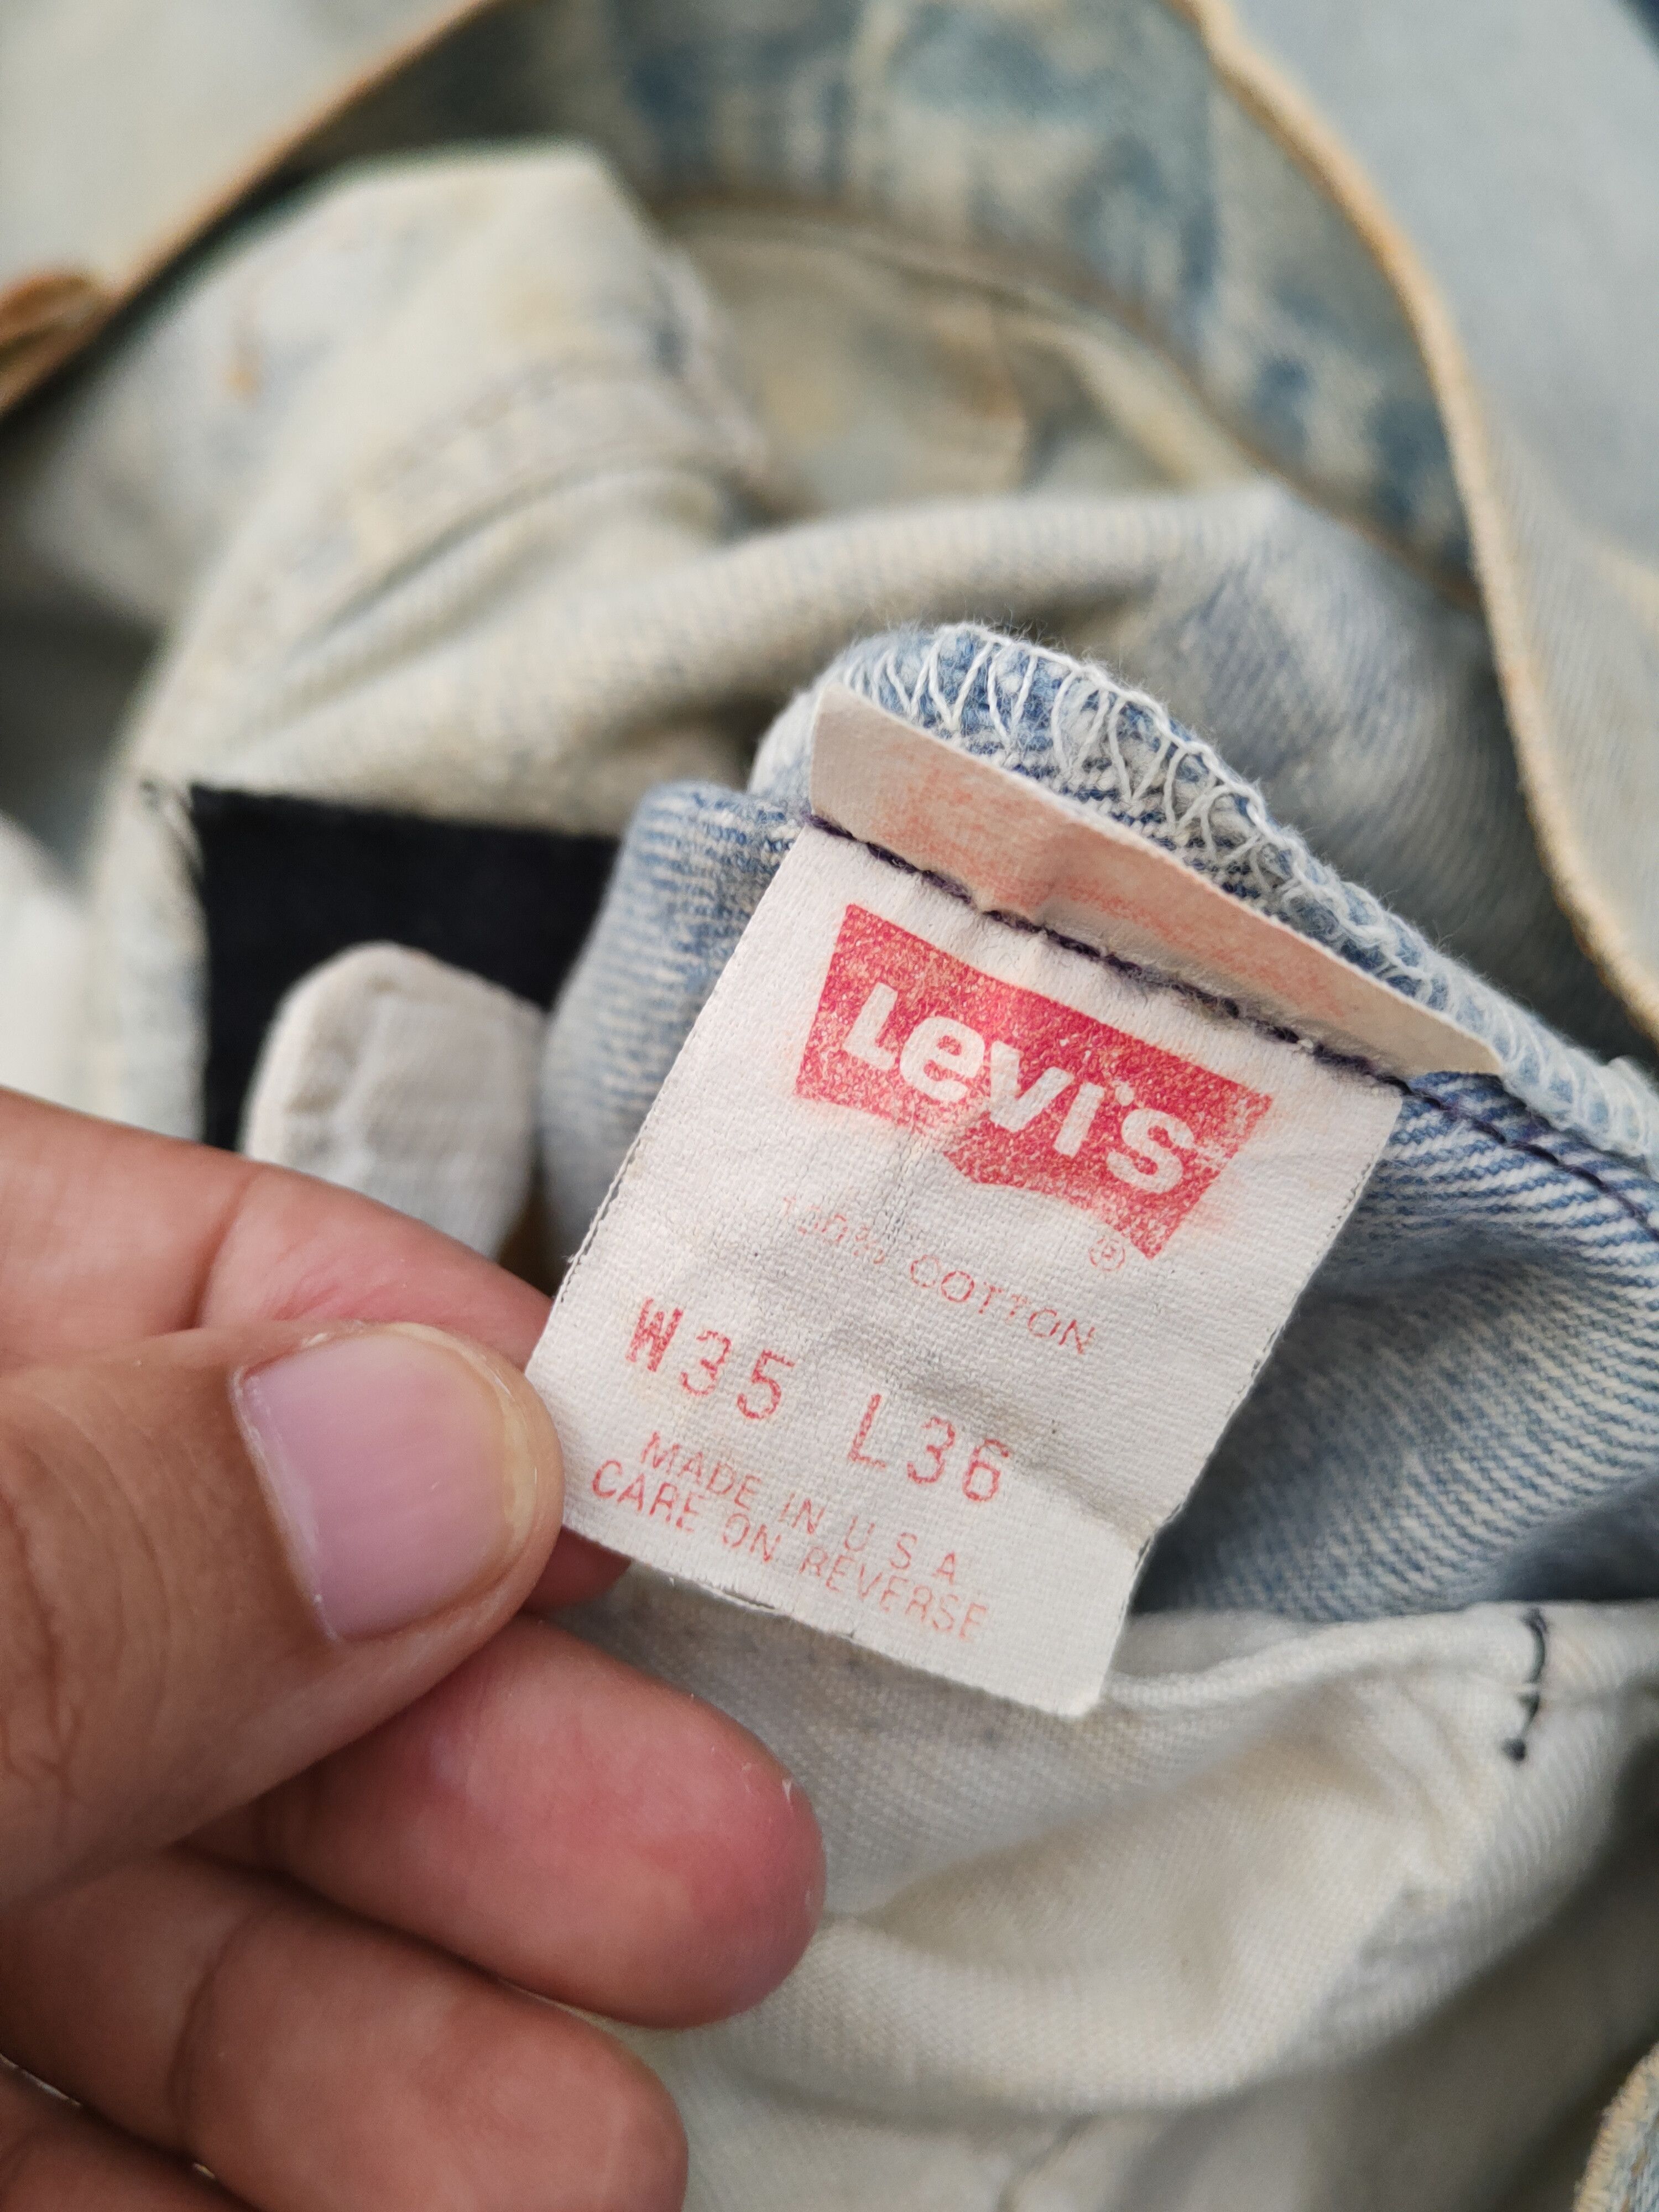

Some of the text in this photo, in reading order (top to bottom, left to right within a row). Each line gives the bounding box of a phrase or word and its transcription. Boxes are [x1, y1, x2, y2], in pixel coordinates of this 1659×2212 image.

[842, 982, 1194, 1193] Levi's
[909, 1254, 1096, 1354] COTTON
[592, 1459, 988, 1644] CARE ON REVERSE
[640, 1431, 762, 1512] MADE
[778, 1492, 826, 1535] IN
